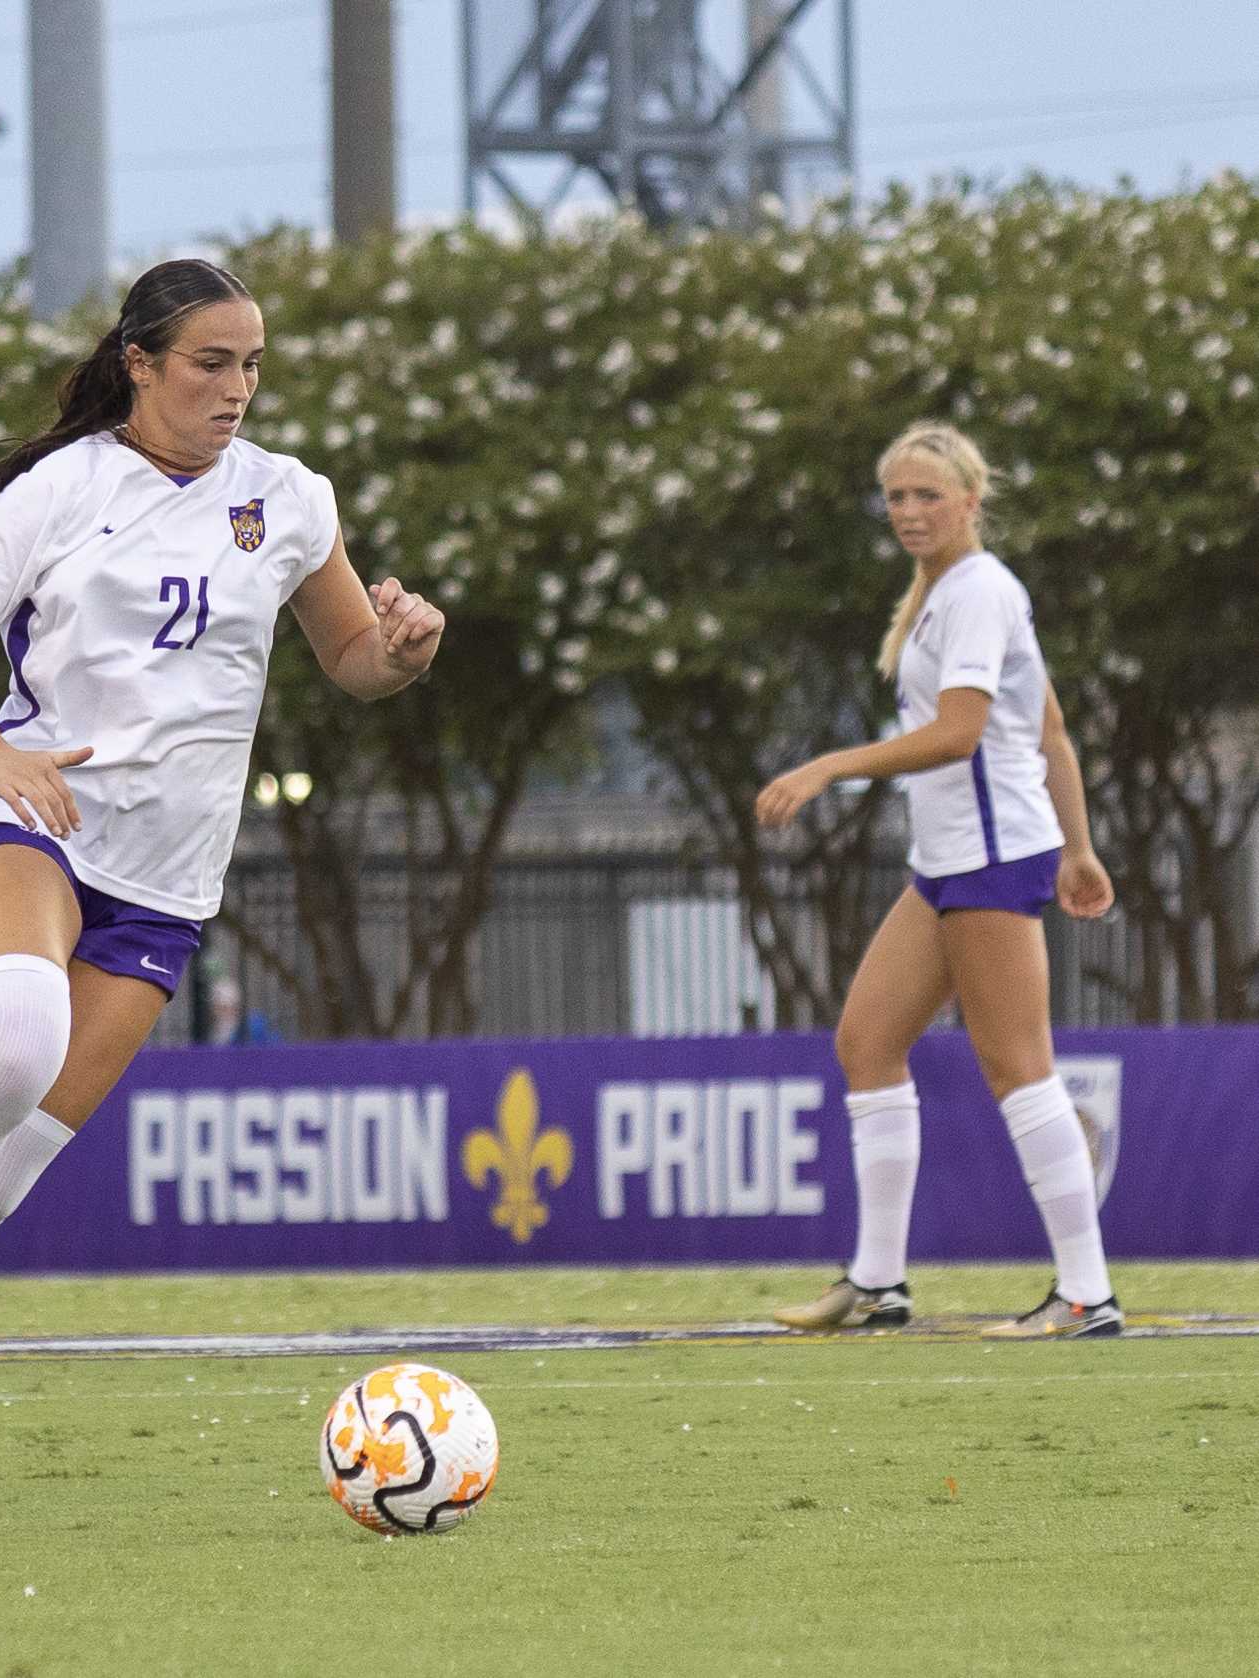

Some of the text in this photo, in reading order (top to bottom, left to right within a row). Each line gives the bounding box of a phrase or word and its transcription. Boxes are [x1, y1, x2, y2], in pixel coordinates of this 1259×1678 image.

[152, 575, 209, 650] 21
[129, 1078, 825, 1226] PASSION PRIDE
